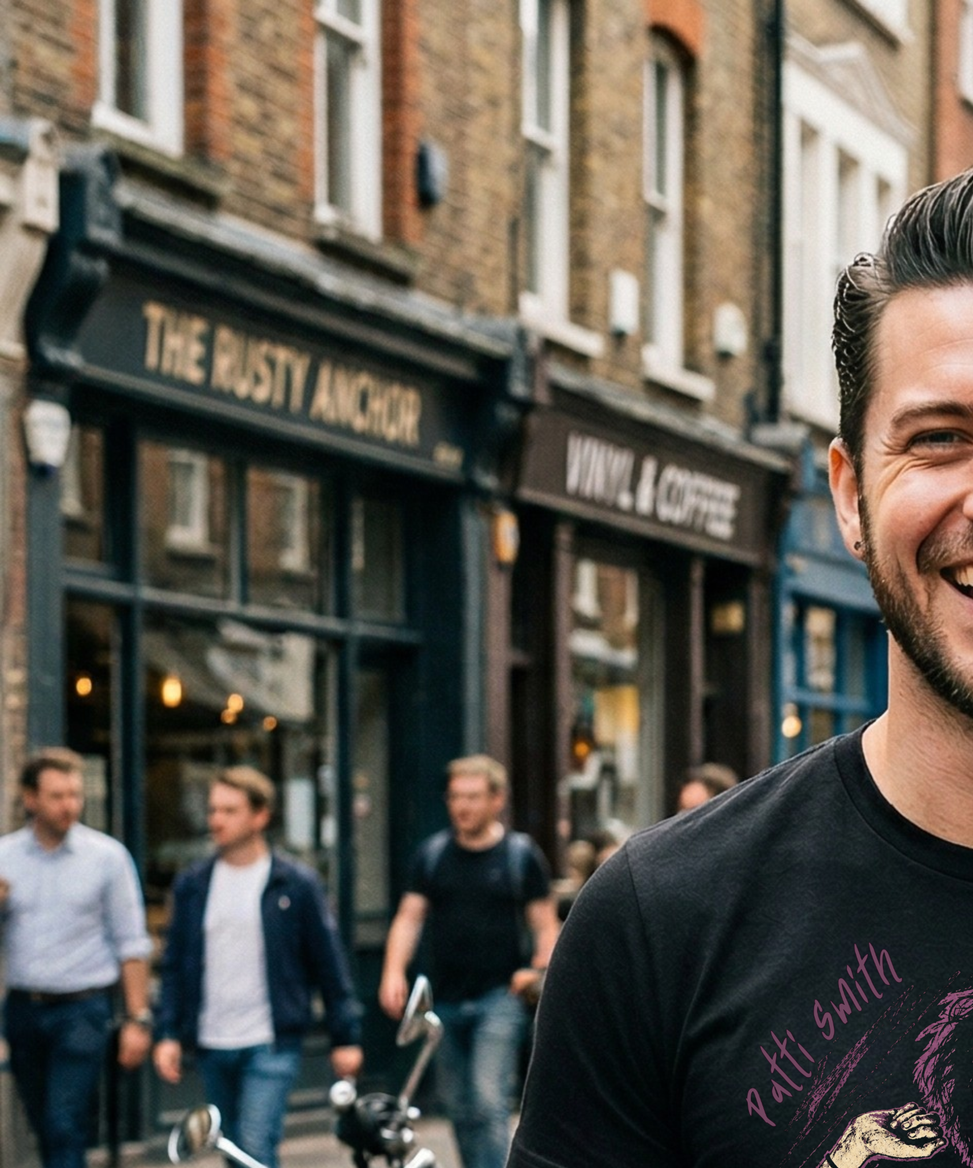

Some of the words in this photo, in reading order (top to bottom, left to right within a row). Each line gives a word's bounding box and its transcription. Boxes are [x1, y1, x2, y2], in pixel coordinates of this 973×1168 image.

[143, 303, 208, 387] THE
[211, 323, 311, 414] RUSTY
[310, 360, 421, 447] ANCHOR
[566, 431, 634, 511] VINYL
[636, 455, 658, 516] &
[656, 463, 741, 540] COFFEE
[746, 1029, 815, 1127] Patti
[813, 942, 903, 1041] Smith
